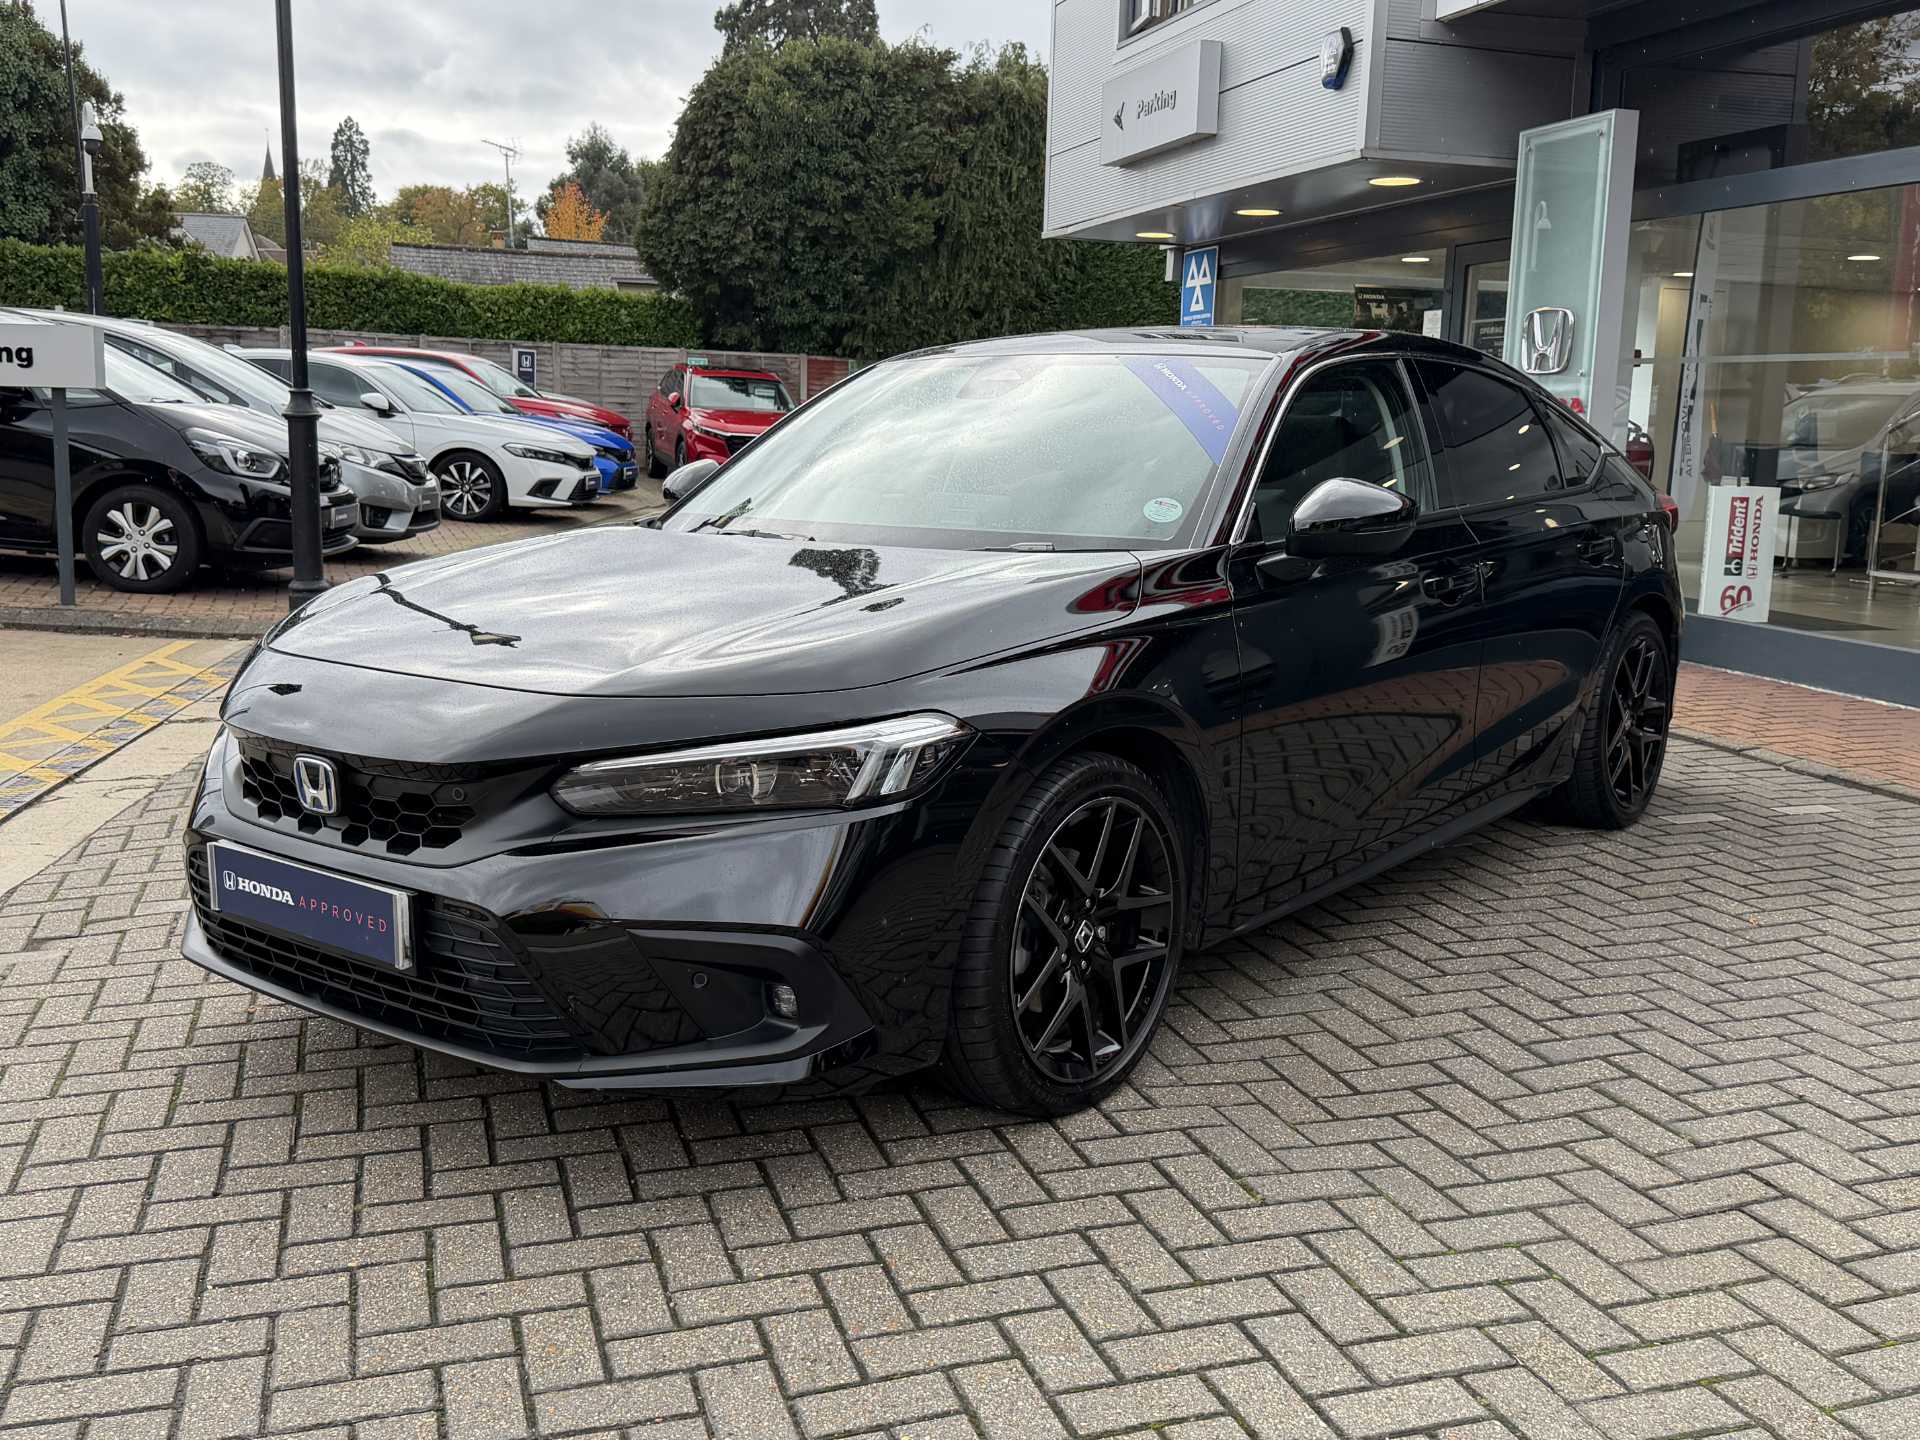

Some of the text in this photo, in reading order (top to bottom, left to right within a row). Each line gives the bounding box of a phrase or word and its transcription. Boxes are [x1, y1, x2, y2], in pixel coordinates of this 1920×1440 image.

[1137, 89, 1177, 120] Parking
[0, 346, 34, 369] ng
[1728, 499, 1747, 555] Trident
[1750, 495, 1764, 561] HONDA
[1720, 584, 1752, 614] 60
[237, 876, 387, 933] HONDA APPROVED
